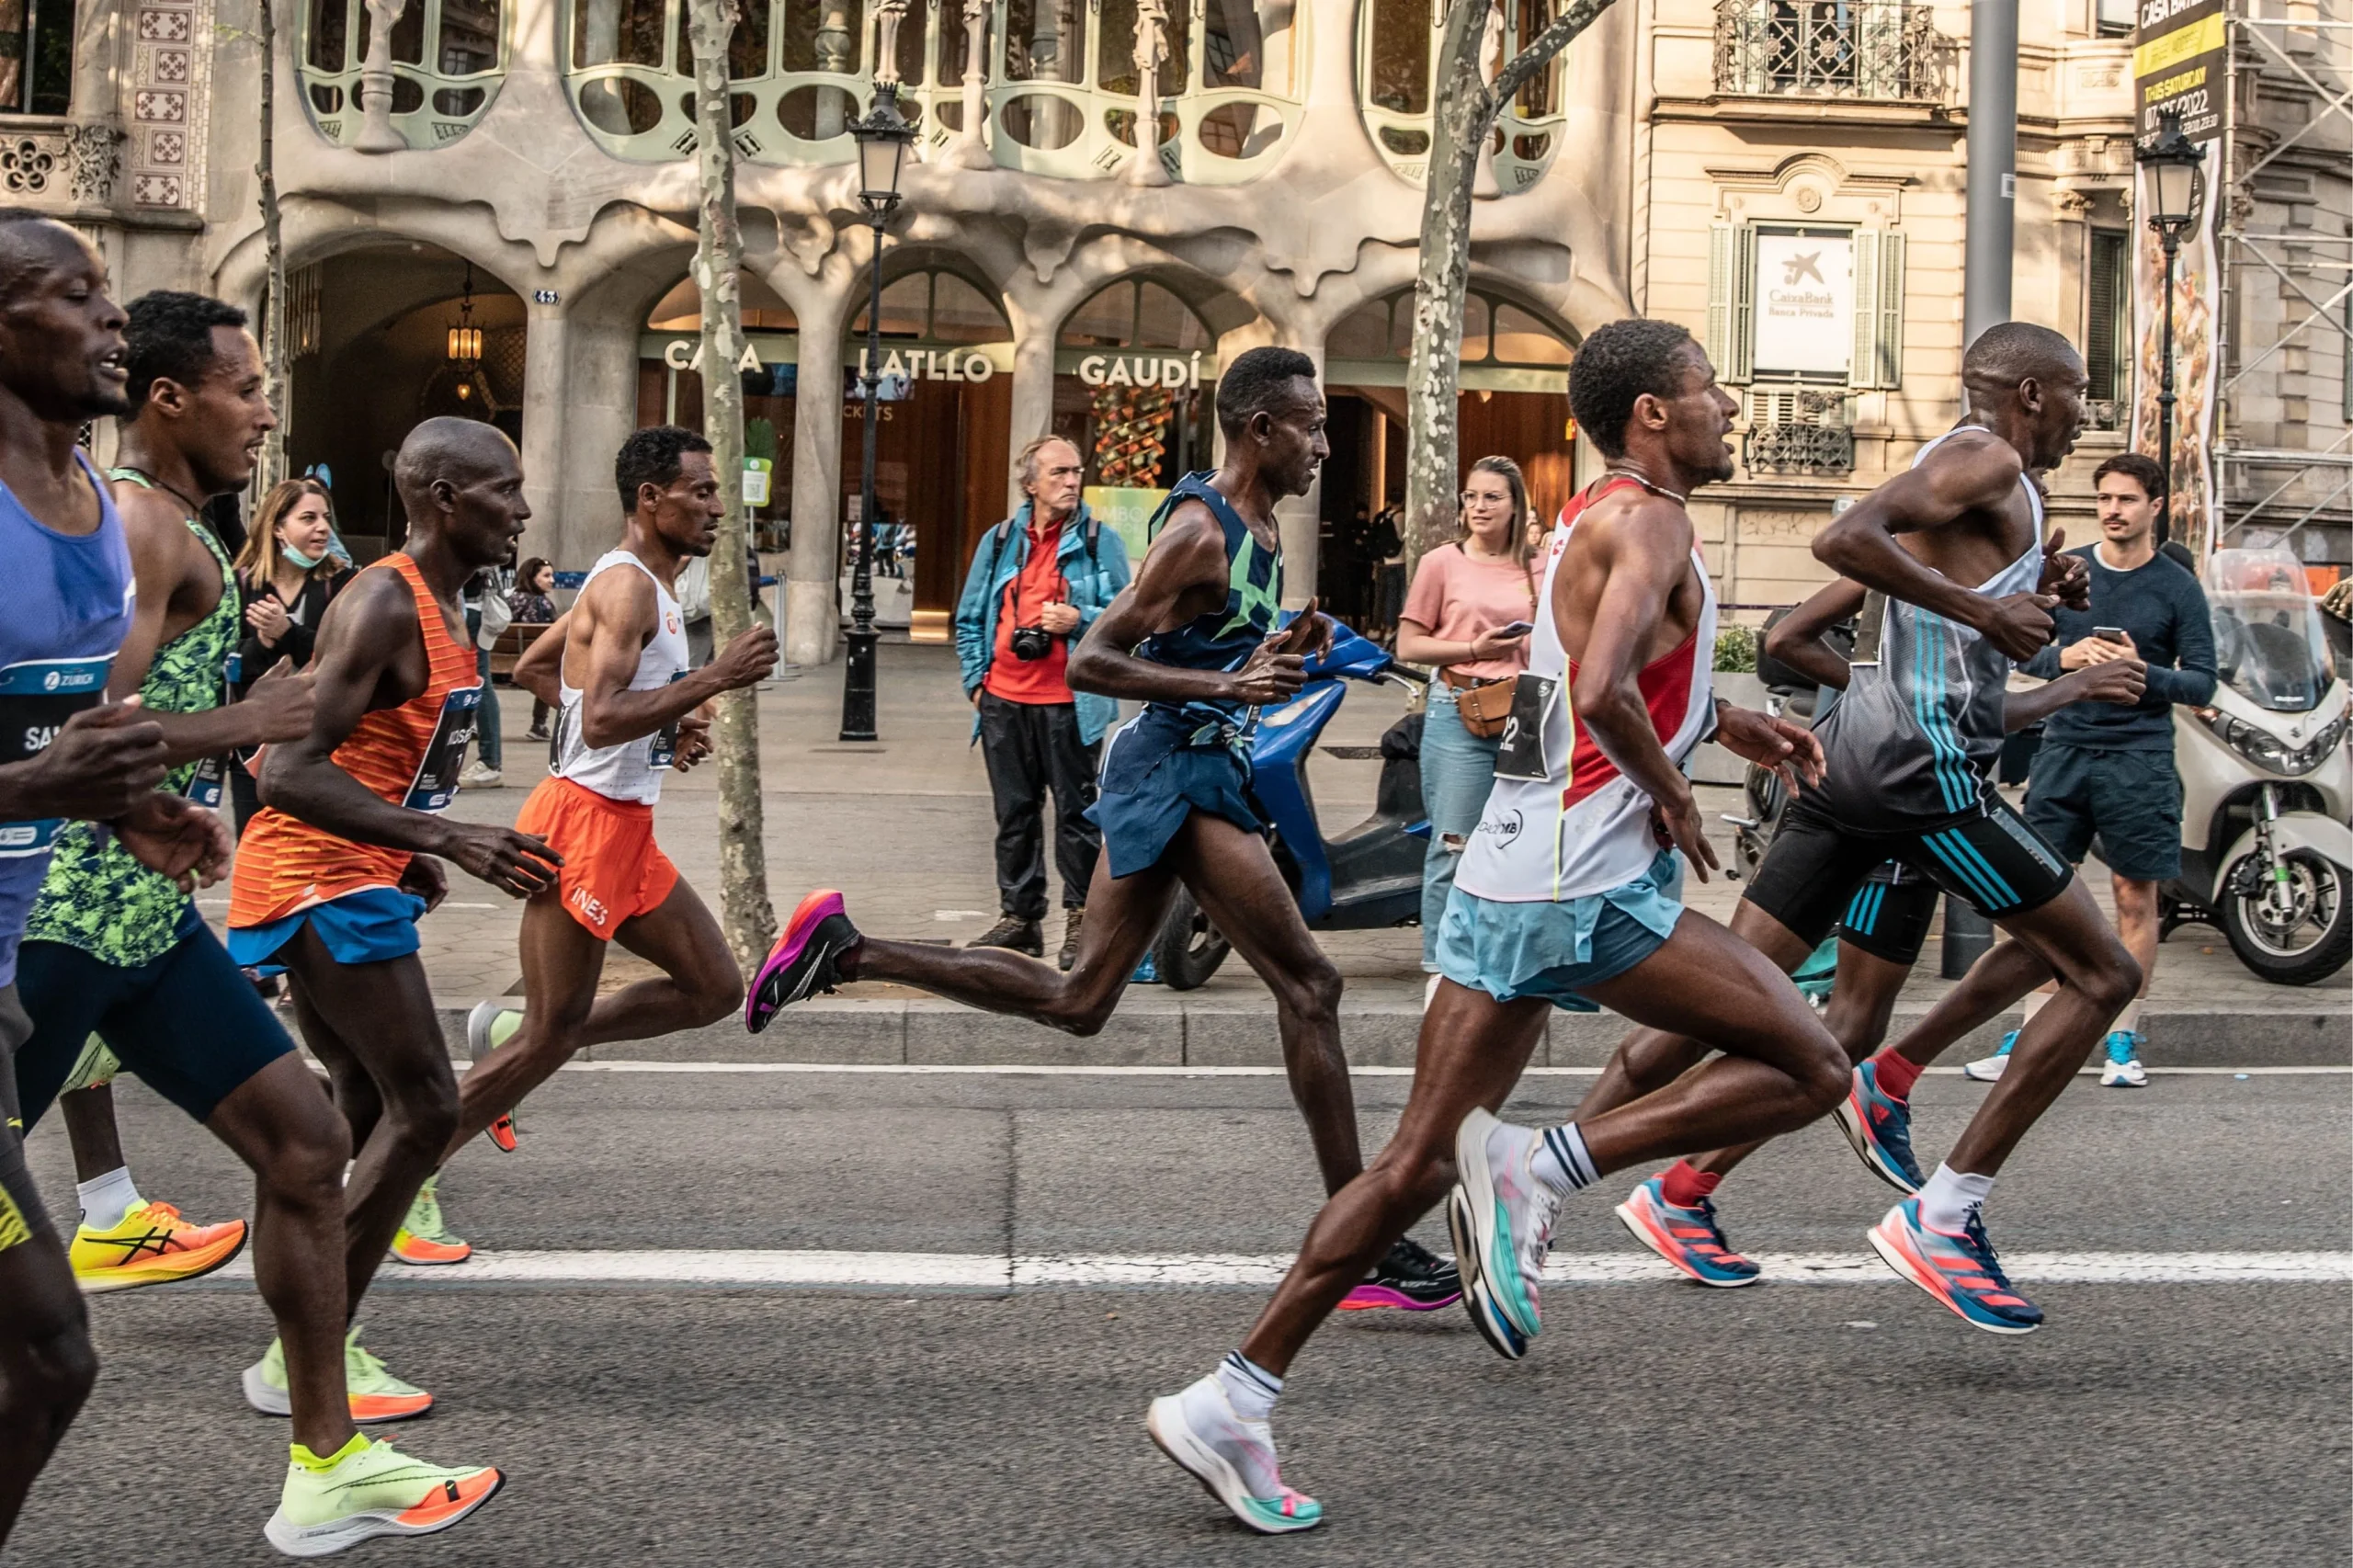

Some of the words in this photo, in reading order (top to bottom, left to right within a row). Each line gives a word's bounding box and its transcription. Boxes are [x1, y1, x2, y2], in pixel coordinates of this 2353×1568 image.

[2165, 66, 2207, 97] SATURDAY
[538, 290, 556, 303] 43
[1769, 290, 1834, 305] CaixaBank
[1768, 306, 1796, 317] Banca
[1800, 308, 1835, 319] Privada
[665, 340, 763, 373] CAA
[859, 348, 994, 382] ATLLO
[1079, 350, 1201, 390] GAUDÍ
[61, 673, 95, 687] ZURICH
[24, 726, 62, 752] SA
